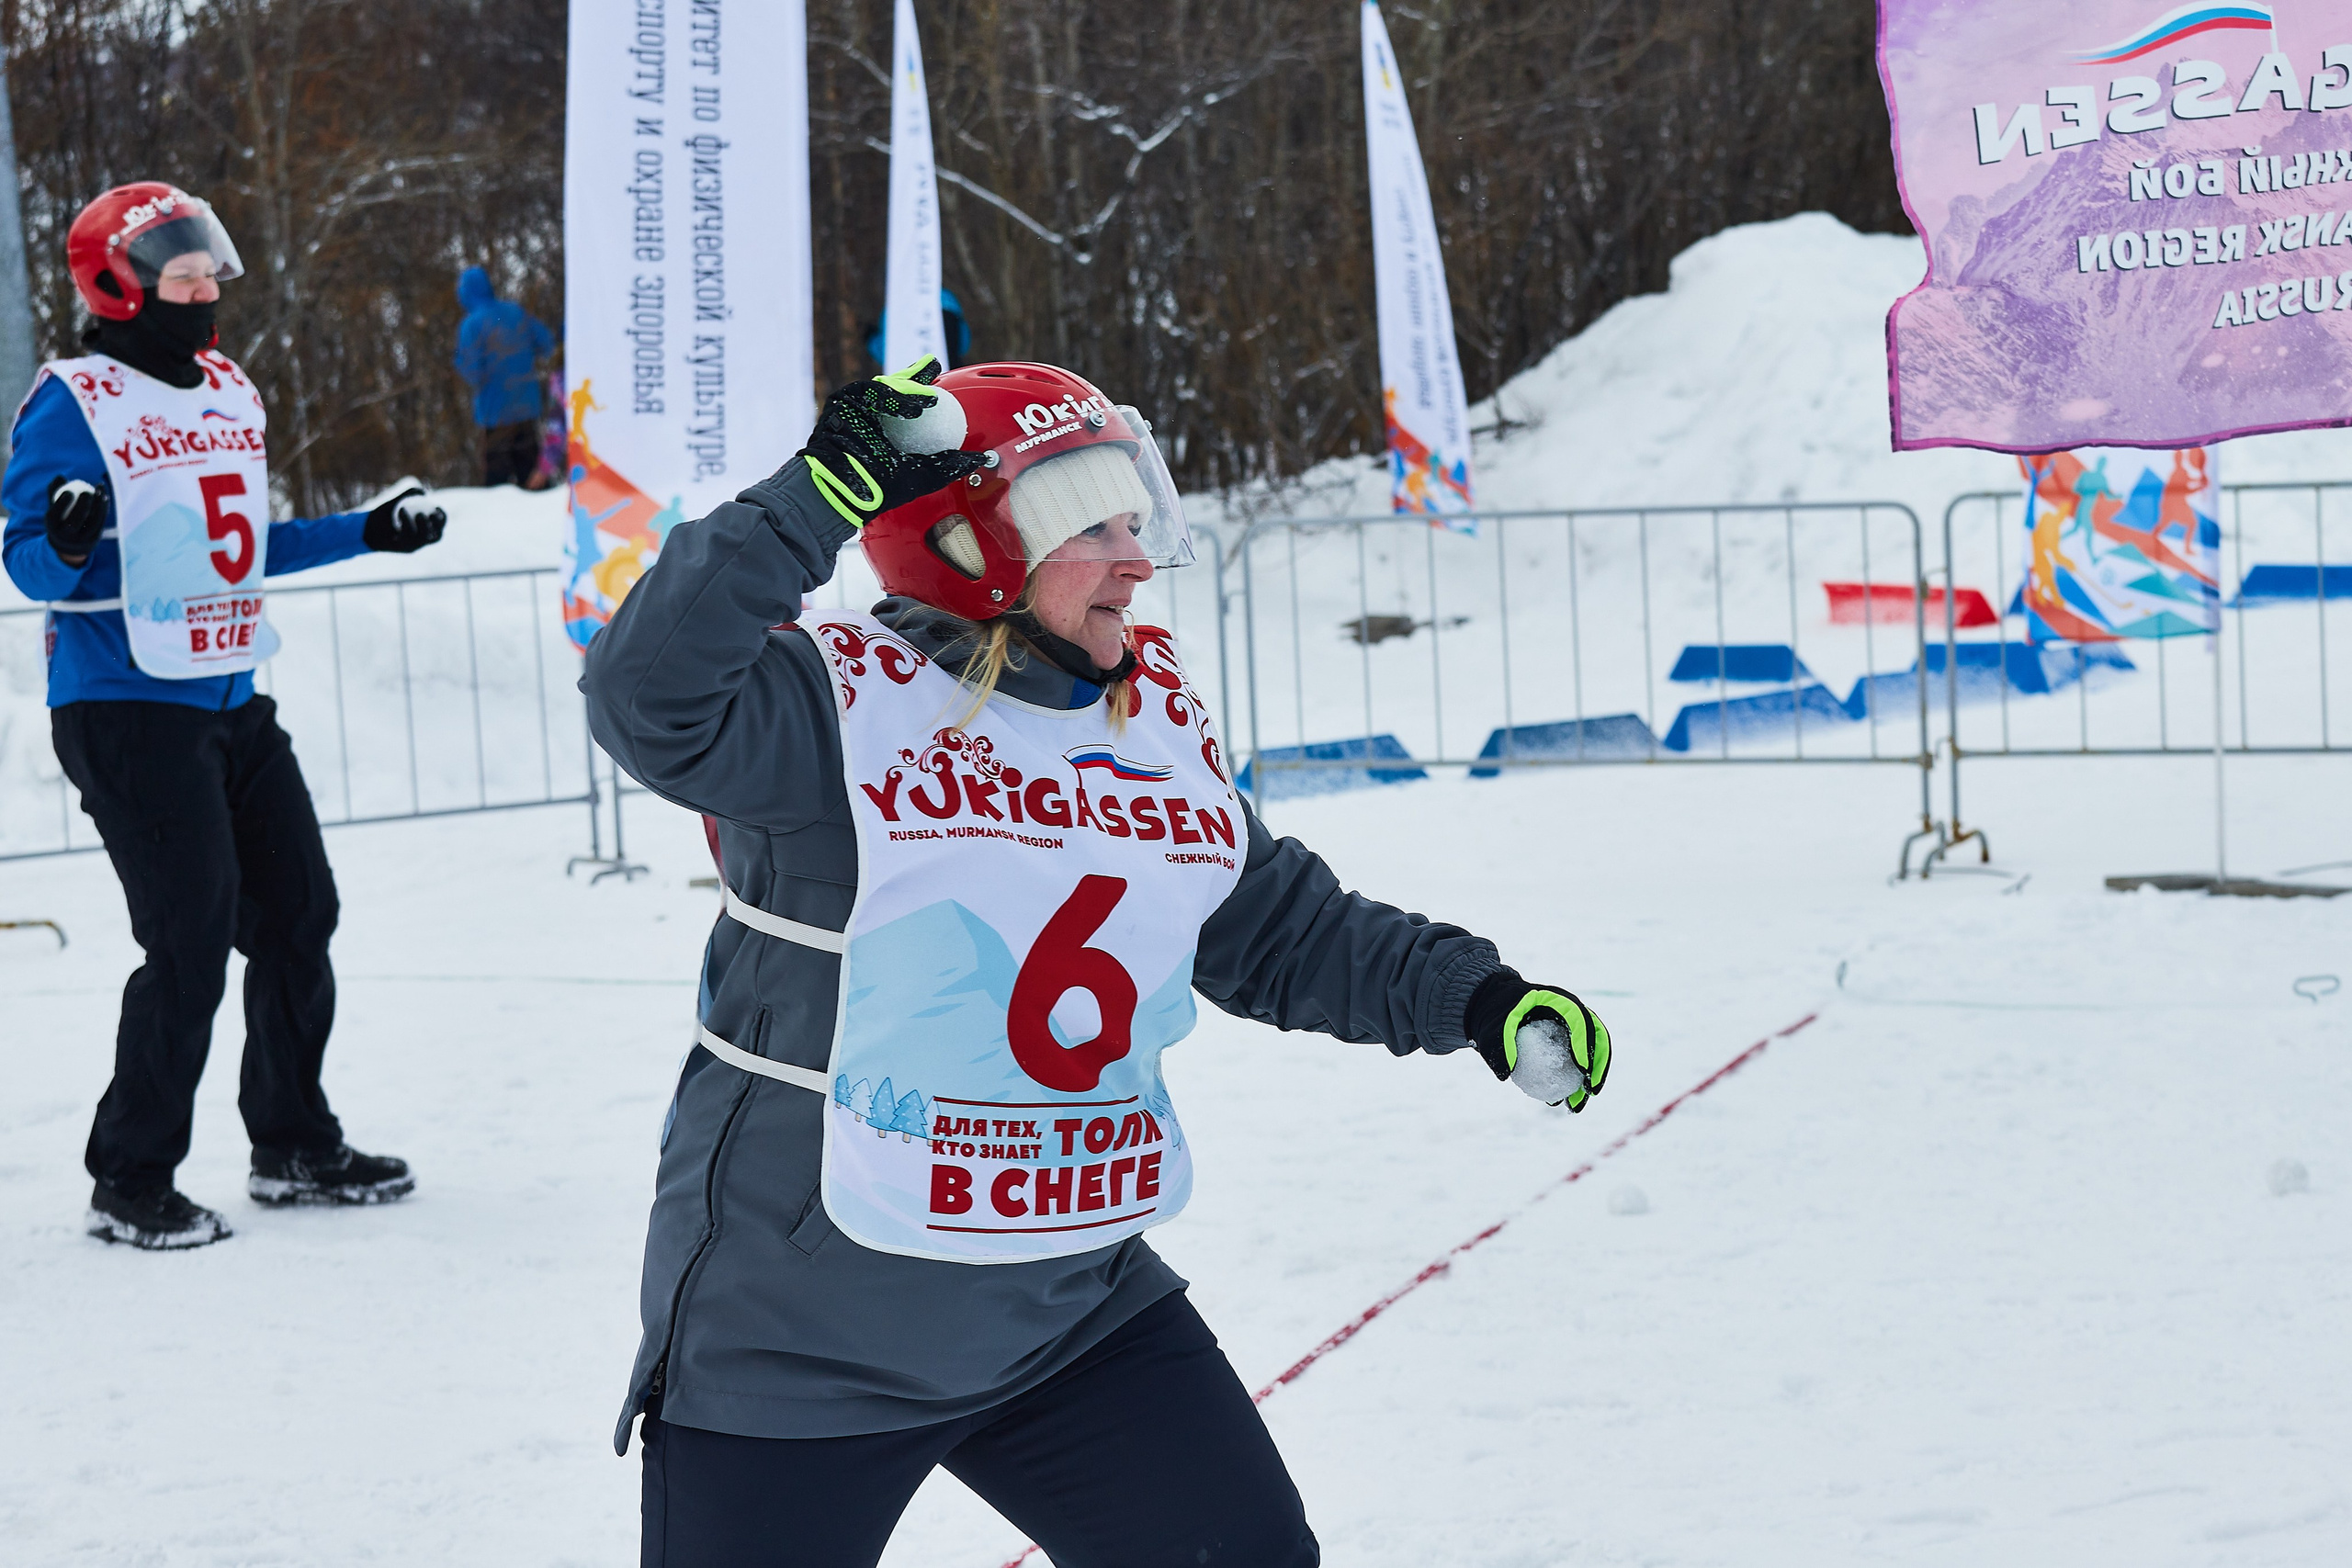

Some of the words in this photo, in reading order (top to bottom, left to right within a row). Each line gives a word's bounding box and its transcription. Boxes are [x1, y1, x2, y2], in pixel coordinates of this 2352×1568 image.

[691, 85, 722, 122] по
[635, 118, 665, 137] и
[627, 150, 666, 264] охране
[683, 133, 732, 322] физической
[625, 275, 666, 416] здоровья
[1013, 421, 1083, 454] МУРМАНСК
[198, 473, 255, 586] 5
[888, 829, 944, 842] RUSSIA,
[945, 827, 1017, 842] MURMANSK
[1016, 834, 1064, 850] REGION
[1165, 852, 1223, 866] СНЕЖНЫЙ
[1007, 874, 1138, 1093] 6
[933, 1114, 988, 1137] ДЛЯ
[991, 1120, 1043, 1140] ТЕХ,
[932, 1140, 976, 1158] КТО
[978, 1144, 1043, 1159] ЗНАЕТ
[929, 1163, 974, 1216] В
[989, 1150, 1163, 1218] СНЕГЕ
